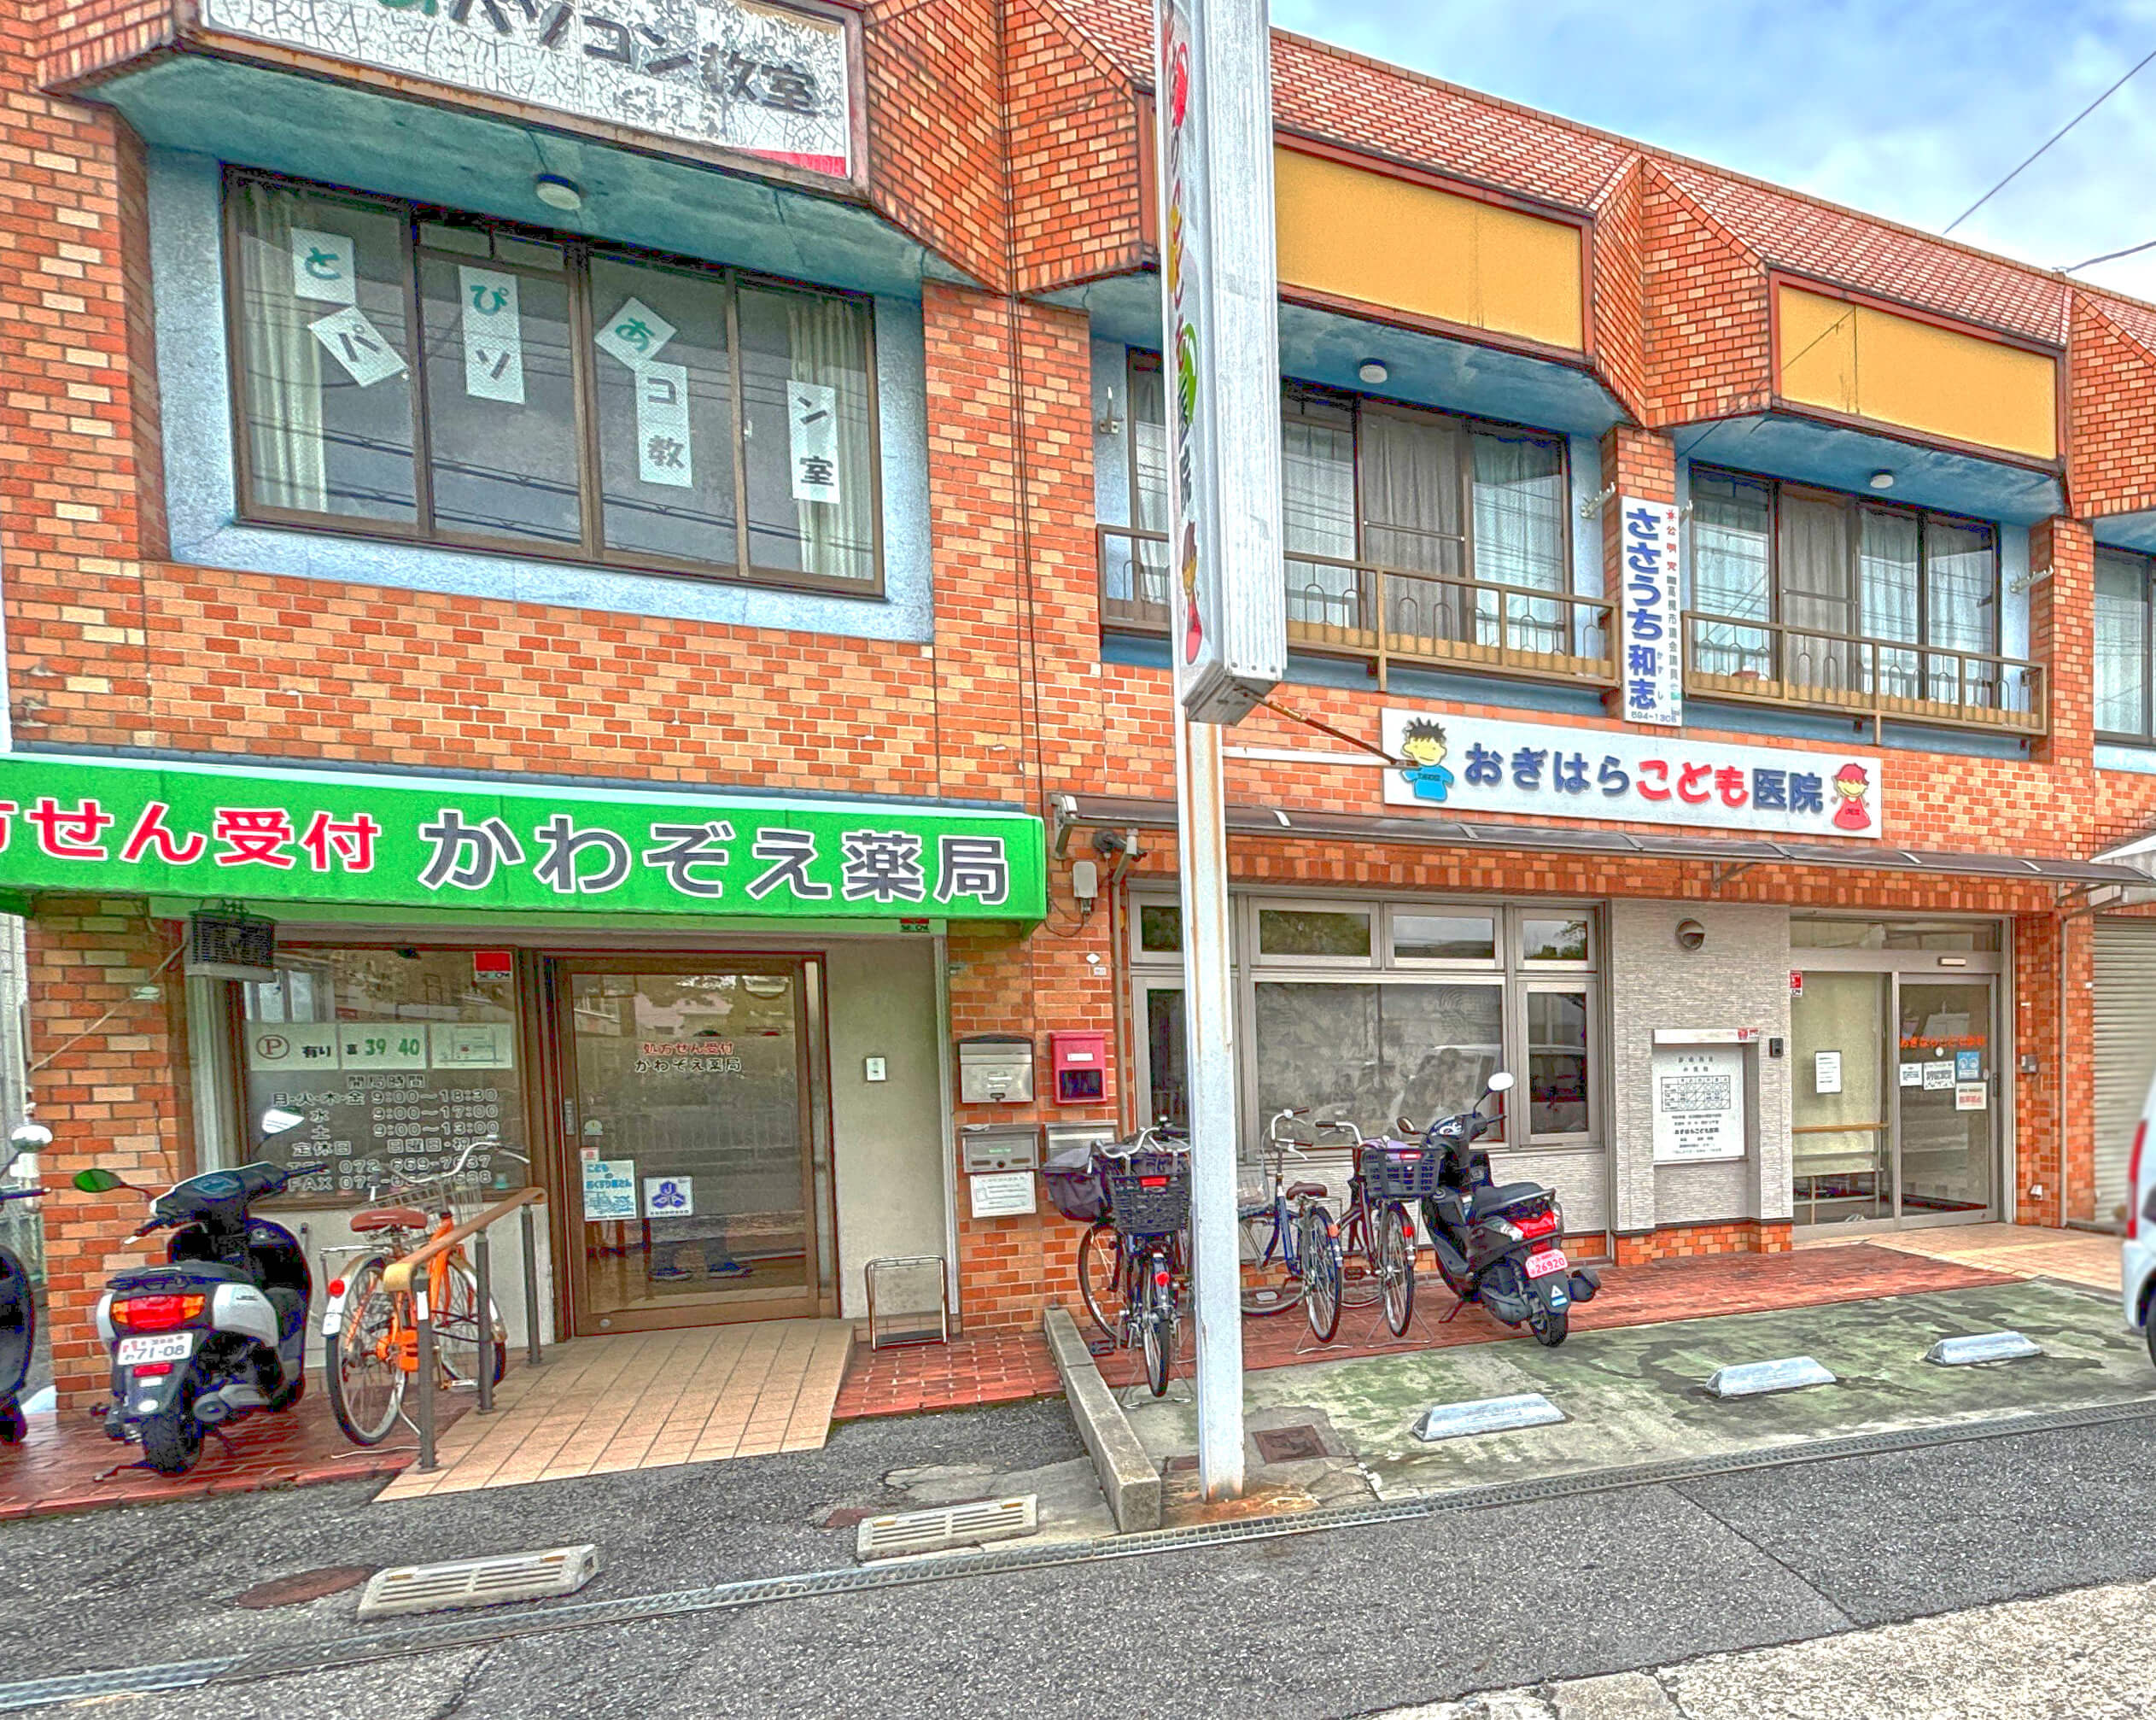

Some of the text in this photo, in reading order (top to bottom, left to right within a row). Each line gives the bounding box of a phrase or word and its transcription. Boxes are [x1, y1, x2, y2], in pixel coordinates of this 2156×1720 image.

[1625, 507, 1663, 710] ささうち和志
[1464, 742, 1824, 813] おぎはらこども医院
[0, 796, 1011, 906] せん受付 かわぞえ薬局
[365, 1038, 387, 1056] 39
[398, 1038, 420, 1056] 40
[309, 1108, 330, 1123] 水
[310, 1124, 331, 1141] 土
[292, 1141, 353, 1156] 定休日
[1535, 1257, 1565, 1274] 26920
[137, 1344, 185, 1360] 71-08
